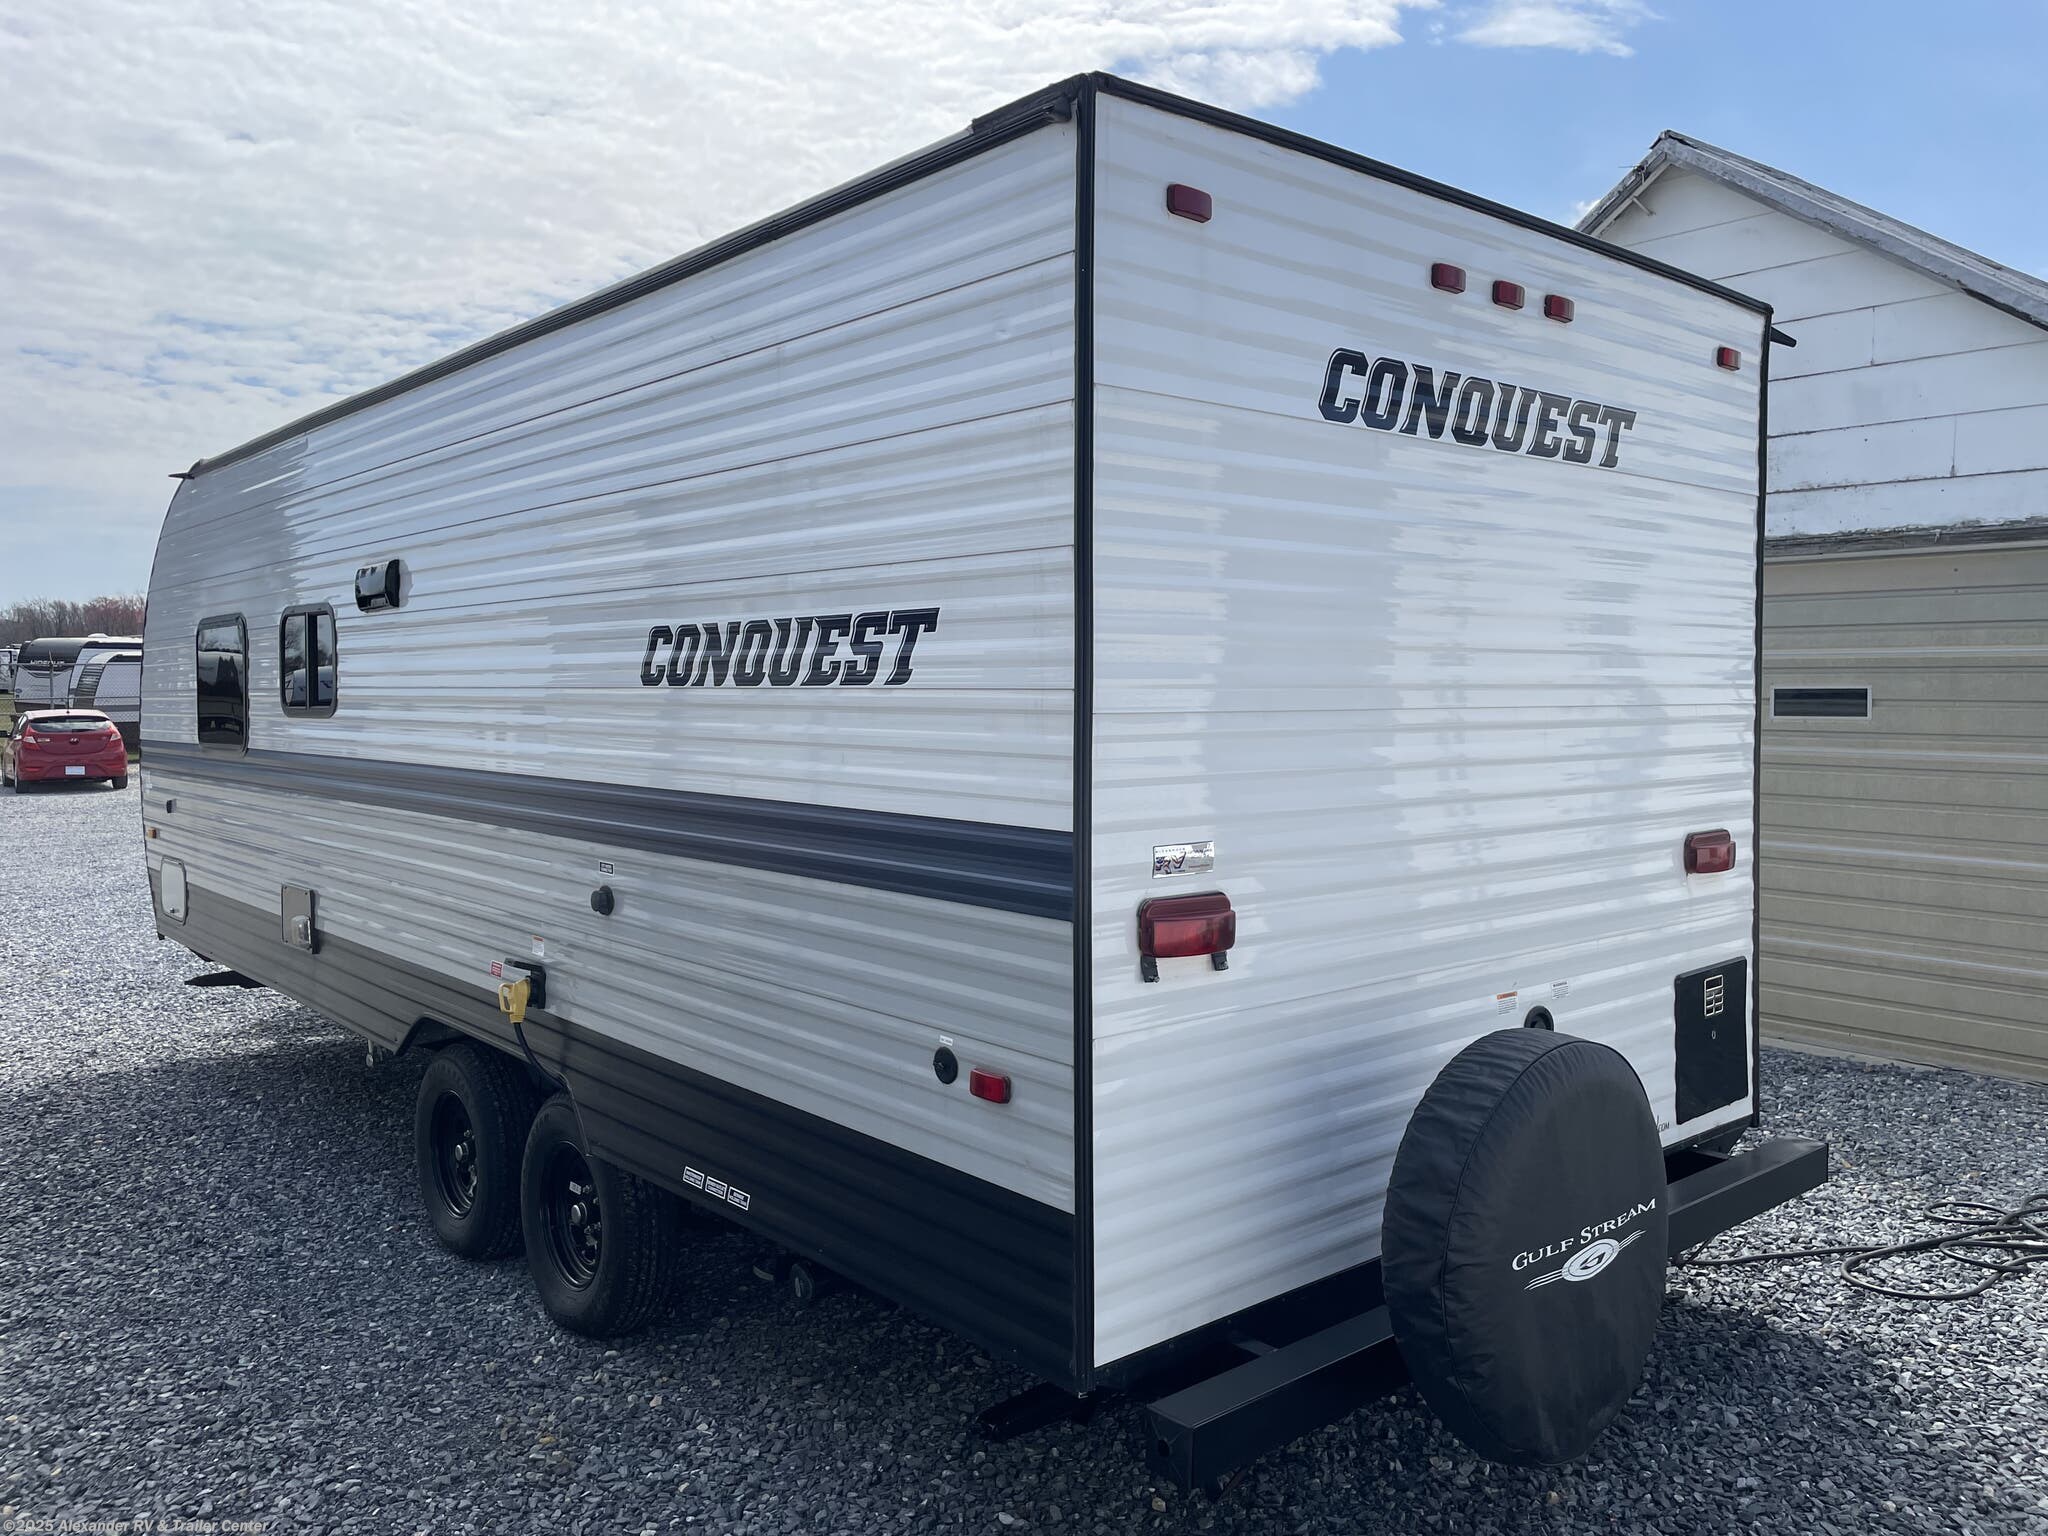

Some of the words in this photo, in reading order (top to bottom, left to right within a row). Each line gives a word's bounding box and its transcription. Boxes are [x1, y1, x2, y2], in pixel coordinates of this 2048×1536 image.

[1318, 347, 1637, 468] CONQUEST
[640, 607, 940, 687] CONQUEST
[1512, 1238, 1574, 1271] GULF
[1580, 1198, 1656, 1245] STREAM
